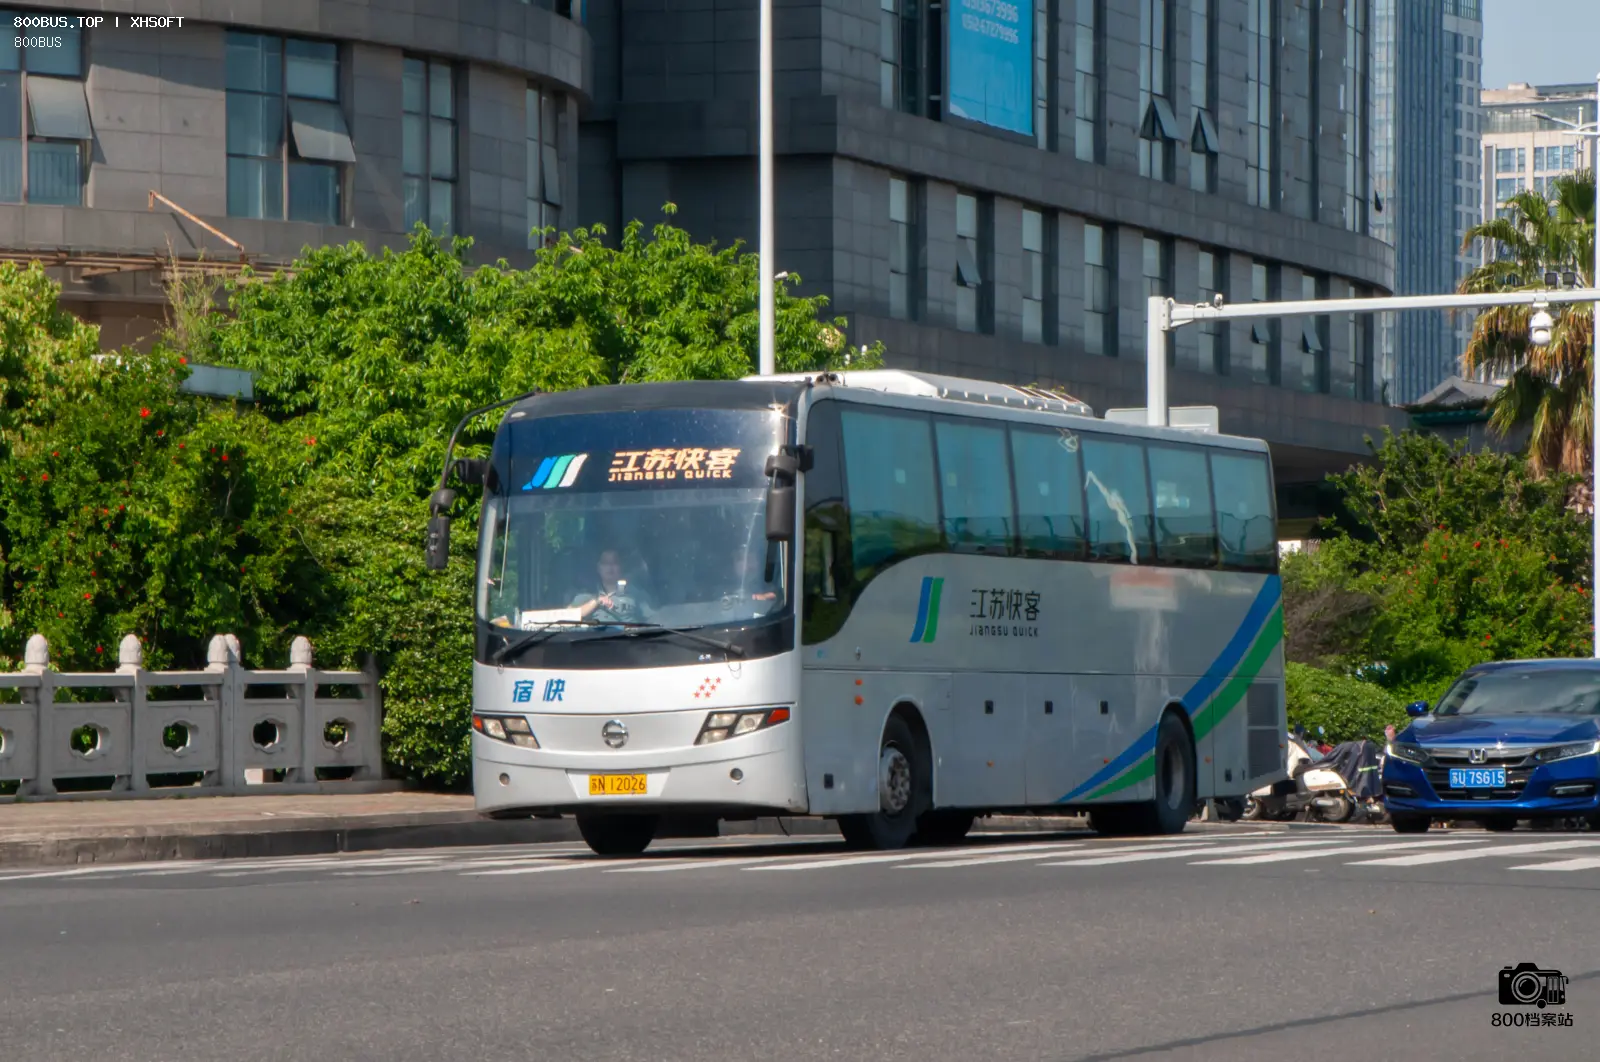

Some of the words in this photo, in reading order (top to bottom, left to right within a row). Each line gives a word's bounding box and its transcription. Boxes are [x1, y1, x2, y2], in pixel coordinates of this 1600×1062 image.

[609, 448, 741, 473] 江苏快客
[970, 588, 1041, 621] 江苏快客
